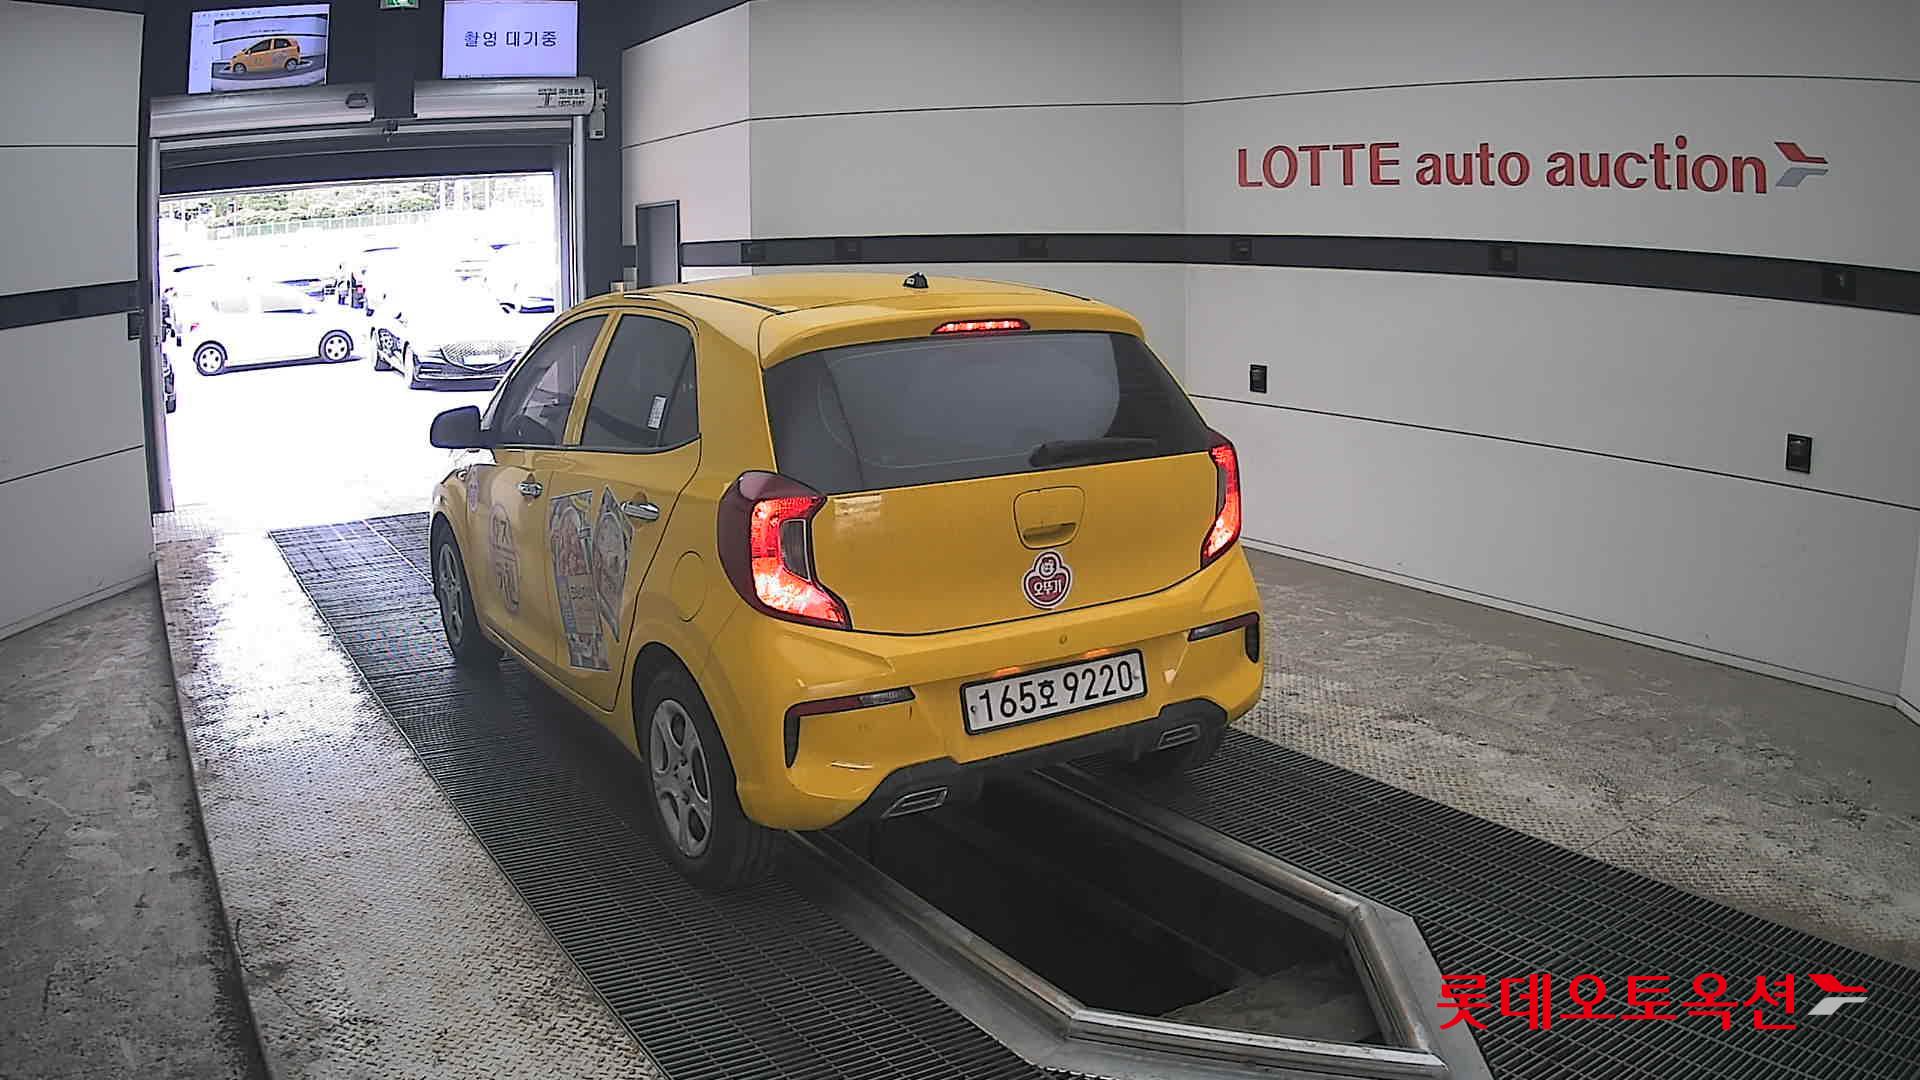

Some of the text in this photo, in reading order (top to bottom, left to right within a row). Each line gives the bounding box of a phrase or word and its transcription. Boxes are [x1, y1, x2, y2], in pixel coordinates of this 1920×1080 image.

[465, 31, 557, 47] 촬영 대기중
[1238, 134, 1768, 194] LOTTE auto auction
[1033, 579, 1062, 597] 오뚜기
